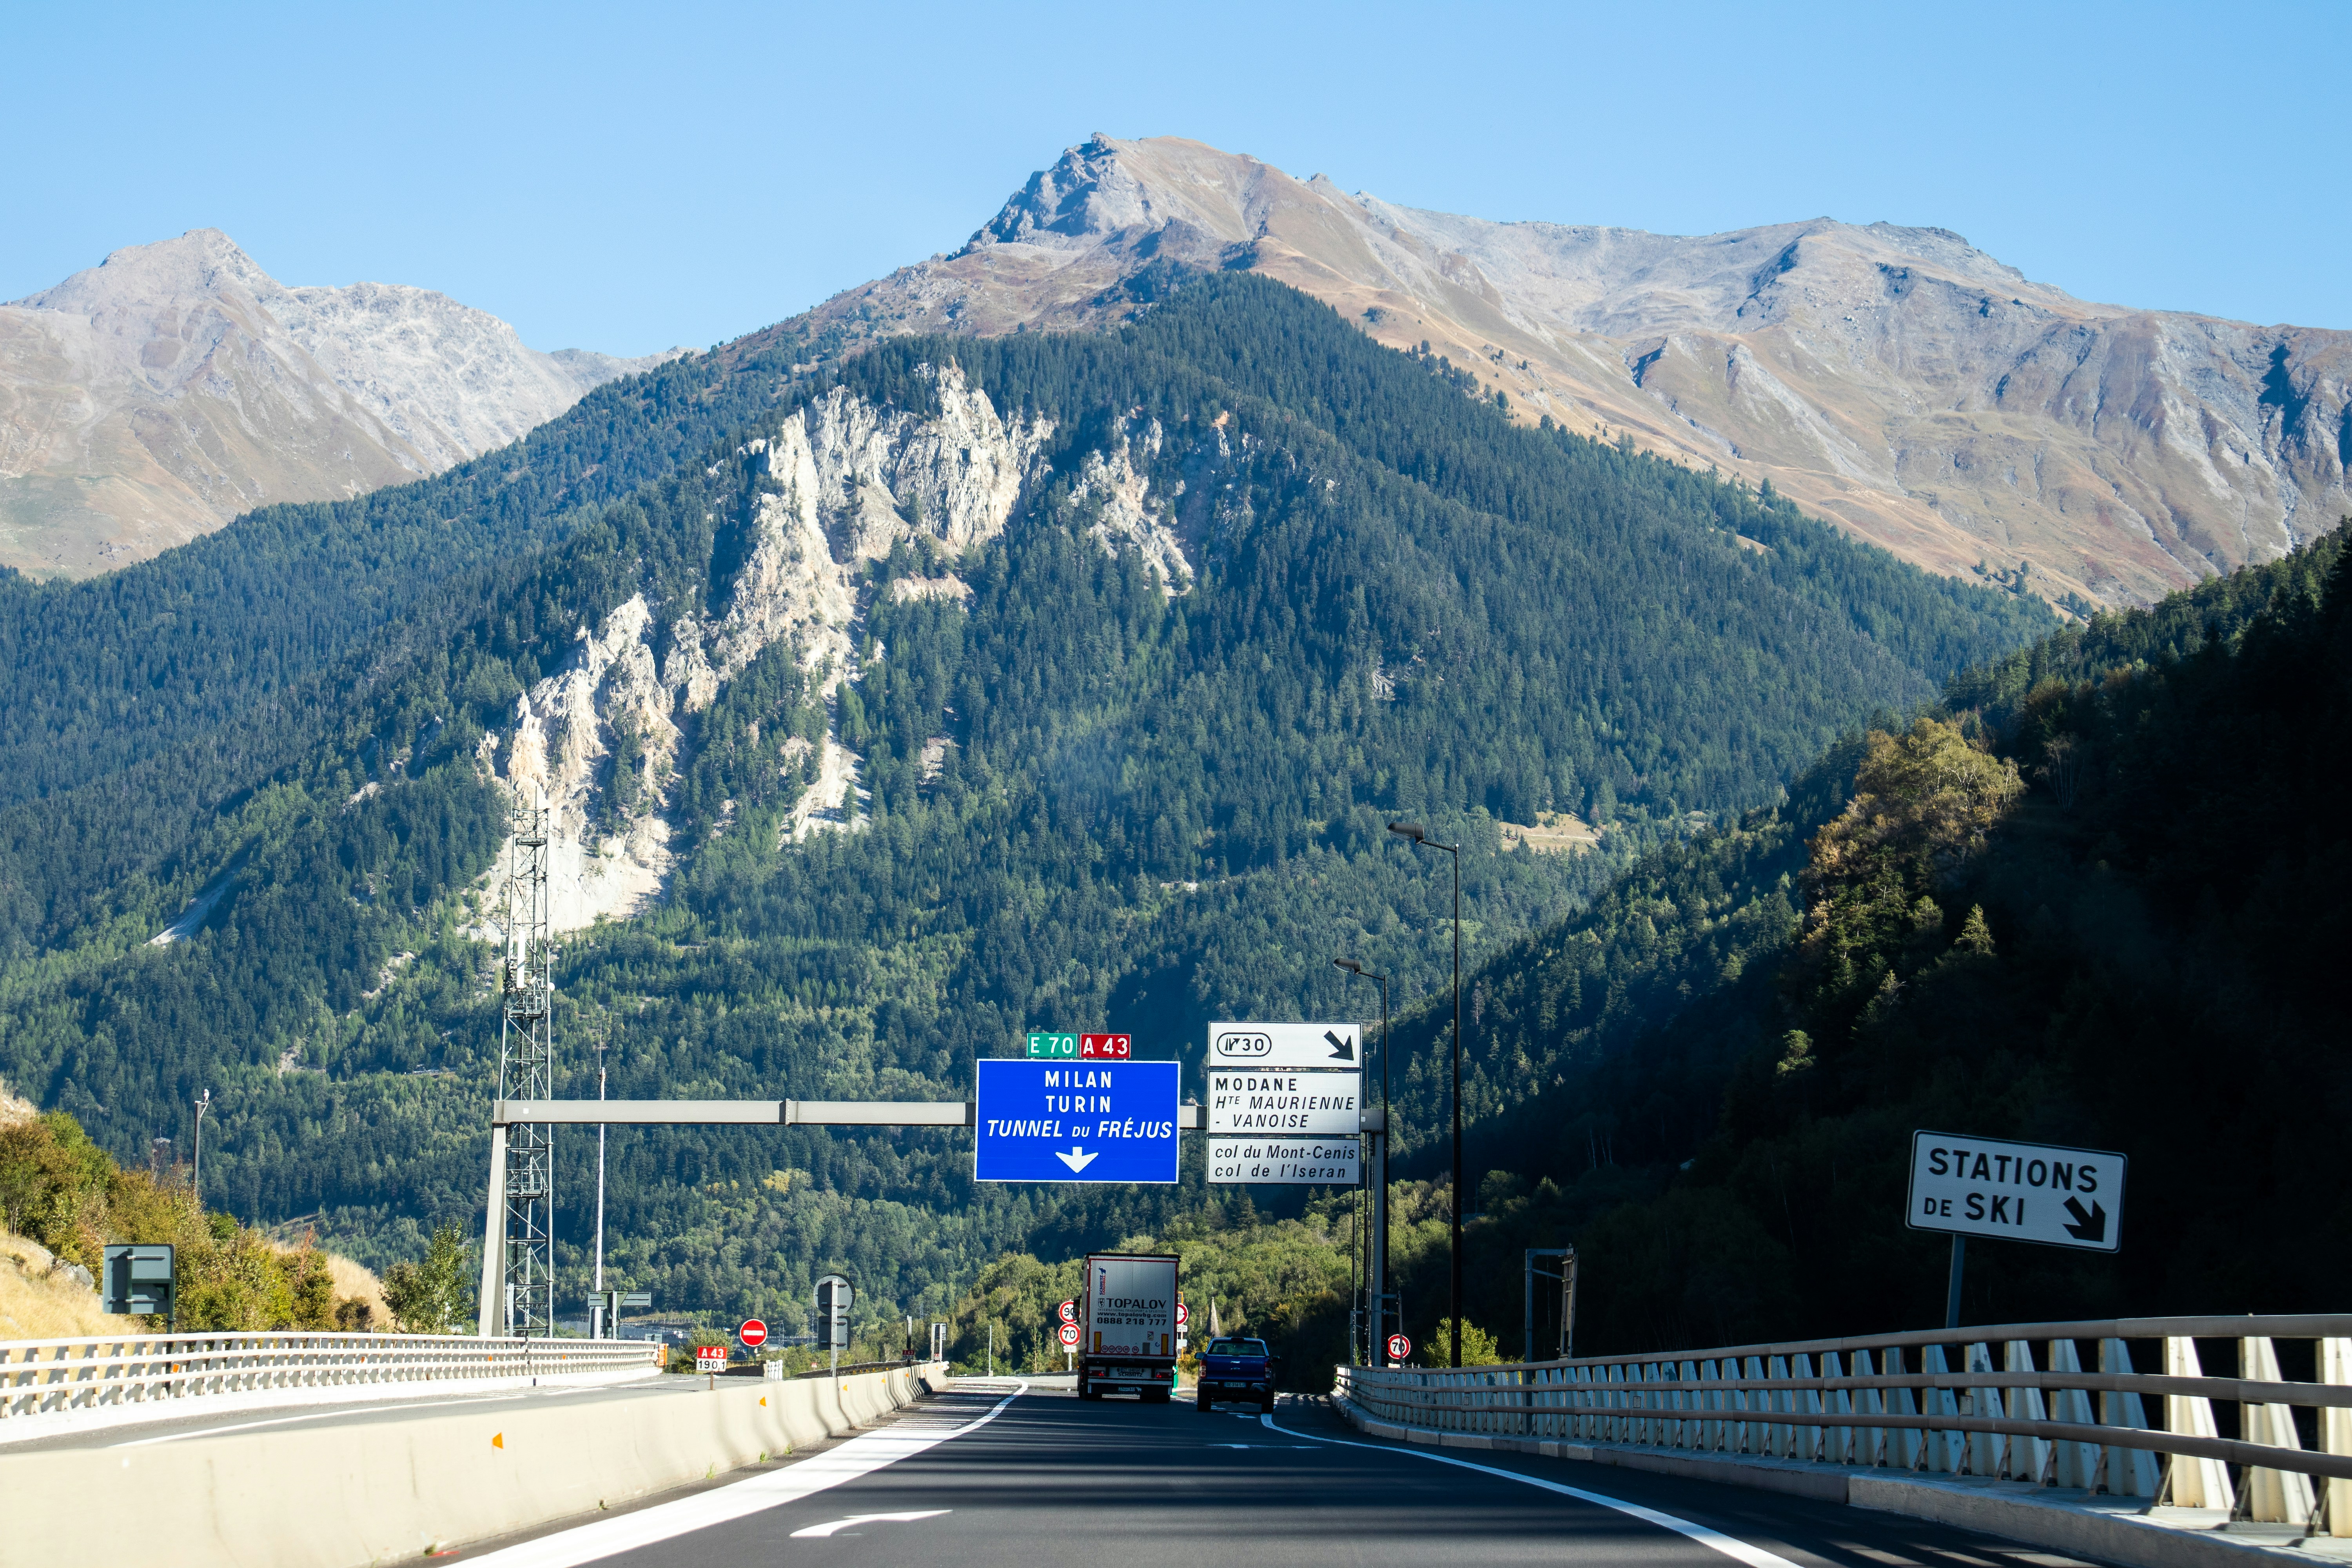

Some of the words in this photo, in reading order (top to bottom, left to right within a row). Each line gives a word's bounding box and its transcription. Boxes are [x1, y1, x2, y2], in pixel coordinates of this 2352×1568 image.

[1031, 1037, 1040, 1053] E
[1049, 1037, 1073, 1054] 70
[1083, 1037, 1094, 1054] A
[1103, 1037, 1128, 1055] 43
[1242, 1038, 1264, 1051] 30
[1045, 1071, 1112, 1088] MILAN
[1216, 1078, 1297, 1091] MODANE
[1045, 1095, 1111, 1113] TURIN
[1249, 1096, 1354, 1110] MAURIENNE
[987, 1120, 1062, 1137] TUNNEL
[1072, 1126, 1090, 1137] DU
[1098, 1117, 1172, 1138] FRÉJUS
[1233, 1114, 1309, 1127] VANOISE
[1215, 1145, 1238, 1158] col
[1244, 1145, 1261, 1158] du
[1267, 1145, 1355, 1160] Mont-Cenis
[1215, 1163, 1241, 1177] col
[1251, 1163, 1270, 1177] de
[1280, 1164, 1345, 1178] l'Iseran
[1928, 1147, 2098, 1193] STATIONS
[1923, 1197, 1953, 1217] DE
[1964, 1192, 2025, 1226] SKI
[1106, 1298, 1167, 1309] TOPALOV
[1063, 1330, 1076, 1339] 70
[701, 1348, 708, 1357] A
[710, 1348, 724, 1358] 43
[1392, 1342, 1405, 1352] 70
[699, 1360, 725, 1371] 190,1
